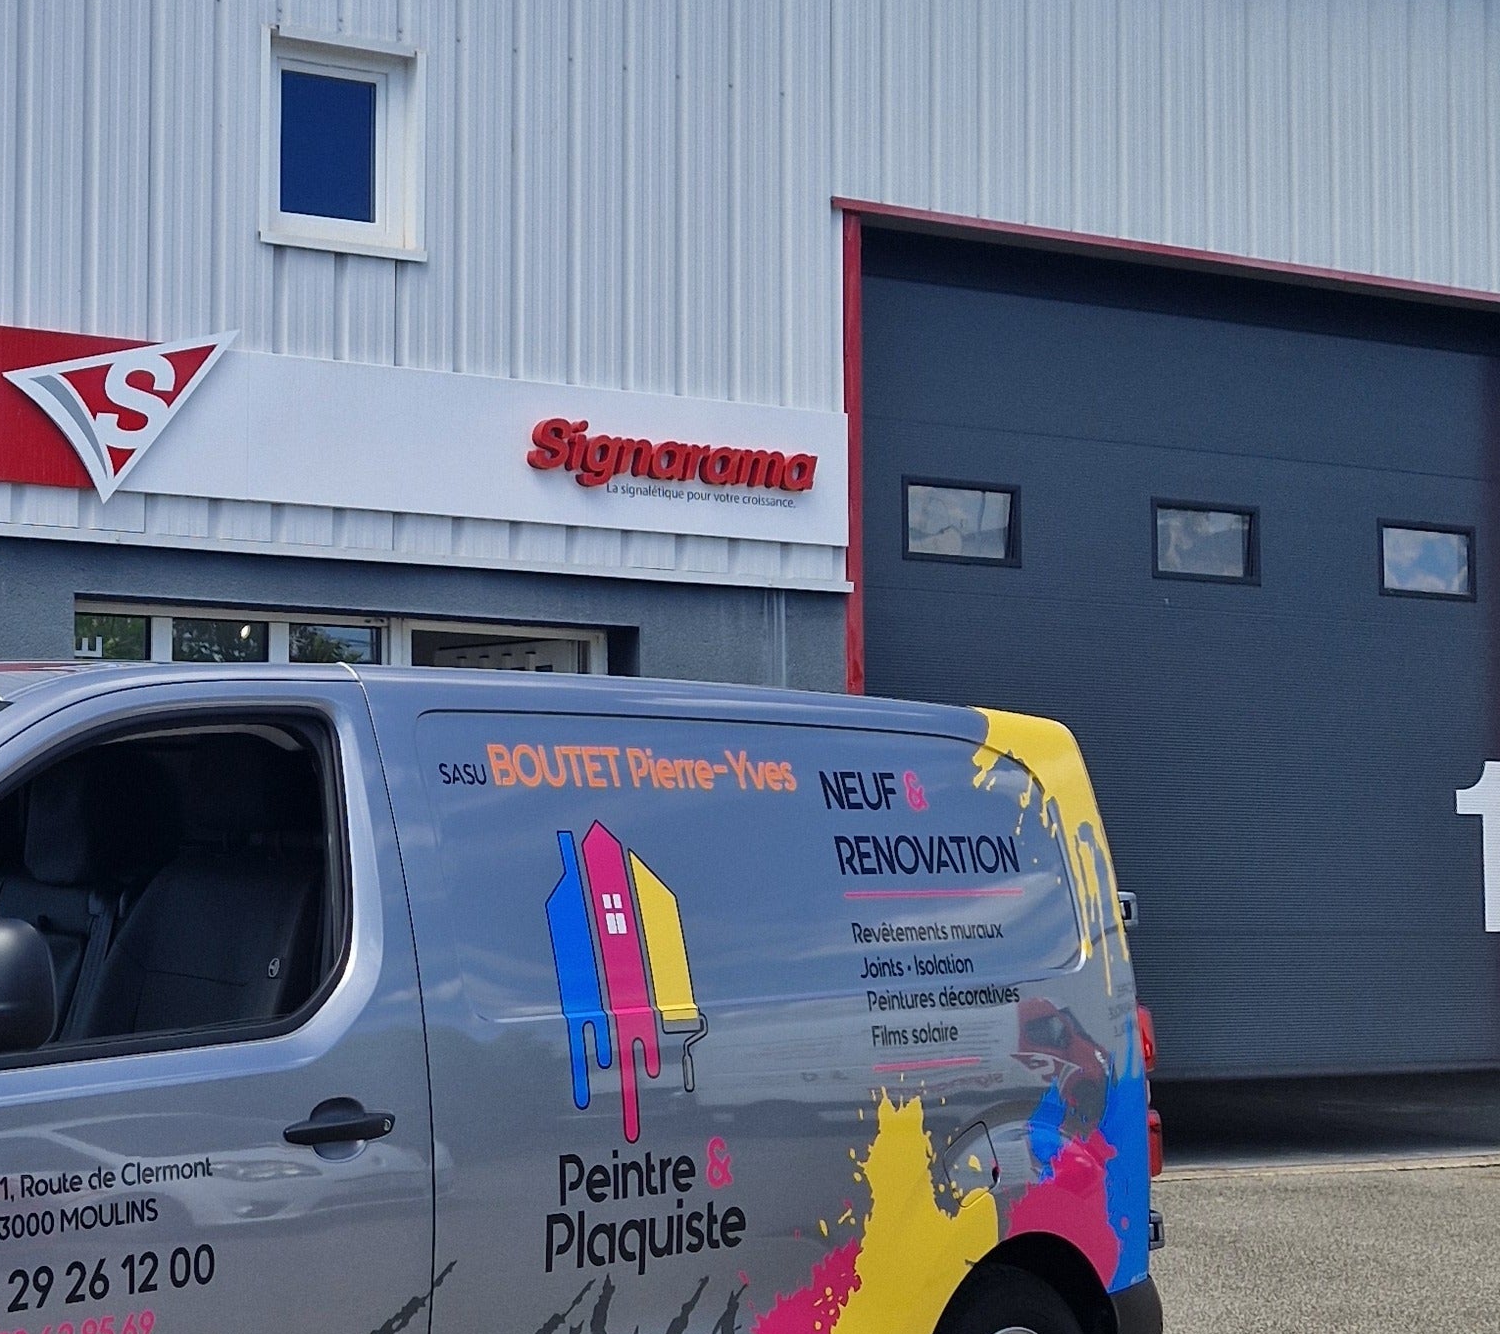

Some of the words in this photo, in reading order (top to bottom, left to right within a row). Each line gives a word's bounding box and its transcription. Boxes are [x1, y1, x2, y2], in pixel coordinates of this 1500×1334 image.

[526, 417, 819, 492] Signarama
[606, 482, 619, 494] La
[621, 484, 685, 501] signalétique
[686, 491, 712, 503] pour
[713, 493, 740, 504] votre
[741, 495, 797, 509] croissance.
[438, 762, 487, 786] SASU
[485, 743, 621, 788] BOUTET
[625, 747, 798, 792] Pierre-Yves
[819, 770, 898, 811] NEUF
[903, 770, 930, 812] &
[833, 834, 1021, 876] RENOVATION
[851, 922, 949, 944] Revêtements
[950, 922, 1004, 940] muraux
[860, 956, 905, 979] Joints
[913, 953, 975, 976] Isolation
[867, 989, 936, 1012] Peintures
[938, 984, 1021, 1008] décoratives
[871, 1024, 909, 1047] Films
[912, 1021, 959, 1044] solaire
[20, 1171, 83, 1199] Route
[88, 1166, 117, 1190] de
[121, 1157, 214, 1187] Clermont
[558, 1149, 696, 1207] Peintre
[705, 1136, 734, 1191] &
[60, 1197, 159, 1233] MOULINS
[545, 1198, 747, 1276] Plaquiste
[7, 1265, 54, 1313] 29
[64, 1257, 110, 1304] 26
[120, 1251, 159, 1295] 12
[169, 1243, 215, 1288] 00
